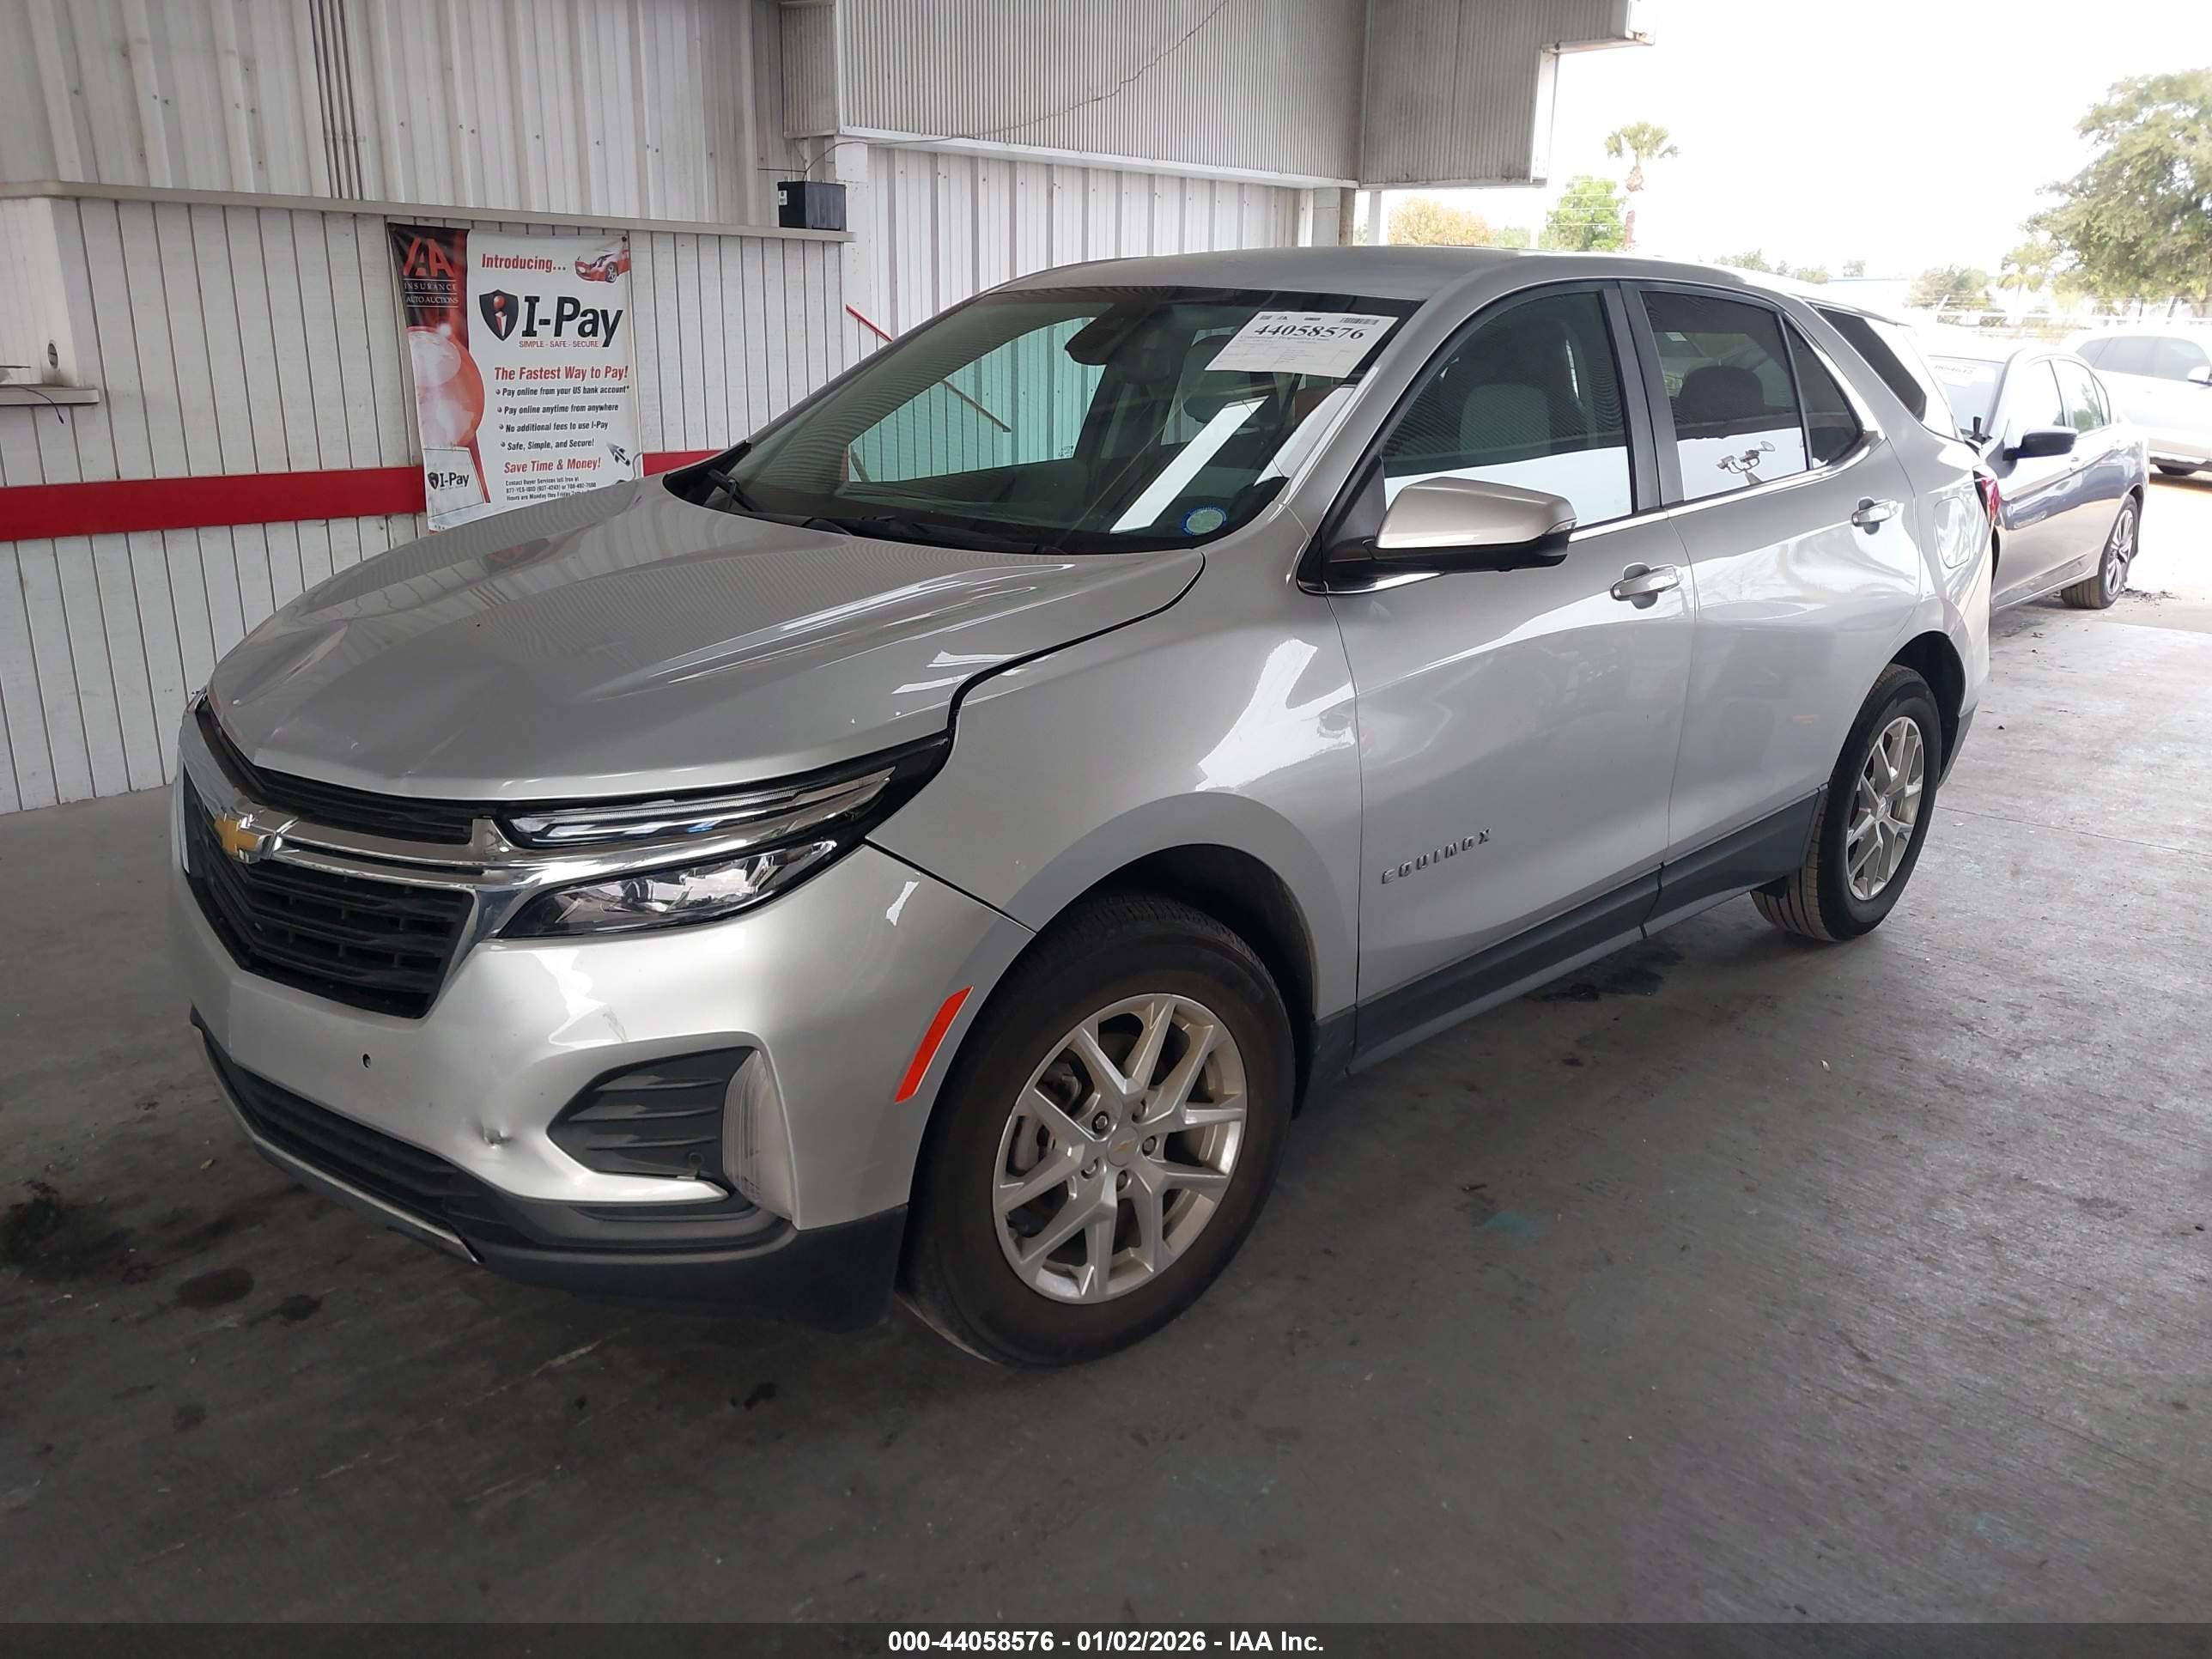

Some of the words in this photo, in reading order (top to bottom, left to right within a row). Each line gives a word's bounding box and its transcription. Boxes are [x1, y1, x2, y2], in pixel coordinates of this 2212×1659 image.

[482, 254, 566, 272] Introducing...
[404, 281, 457, 290] INSURANCE
[521, 295, 624, 348] I-Pay
[1254, 324, 1368, 340] 44058576
[495, 367, 515, 380] The
[519, 367, 561, 380] Fastest
[565, 366, 587, 381] Way
[591, 367, 601, 379] to
[605, 365, 629, 380] Pay!
[502, 388, 515, 398] Pay
[517, 387, 538, 396] online
[540, 386, 555, 395] from
[556, 387, 571, 397] your
[504, 406, 517, 416] Pay
[519, 405, 540, 414] online
[542, 404, 568, 414] anytime
[570, 404, 586, 412] from
[587, 404, 618, 413] anywhere
[506, 424, 514, 433] No
[517, 422, 551, 432] additional
[553, 422, 568, 430] fees
[569, 422, 576, 430] to
[591, 421, 608, 430] I-Pay
[507, 442, 526, 452] Safe,
[527, 441, 553, 451] Simple,
[555, 440, 568, 448] and
[569, 438, 594, 447] Secure!
[504, 462, 527, 473] Save
[531, 460, 554, 471] Time
[556, 459, 564, 470] &
[567, 457, 601, 471] Money!
[440, 472, 469, 487] I-Pay
[1381, 828, 1491, 884] EQUINOX
